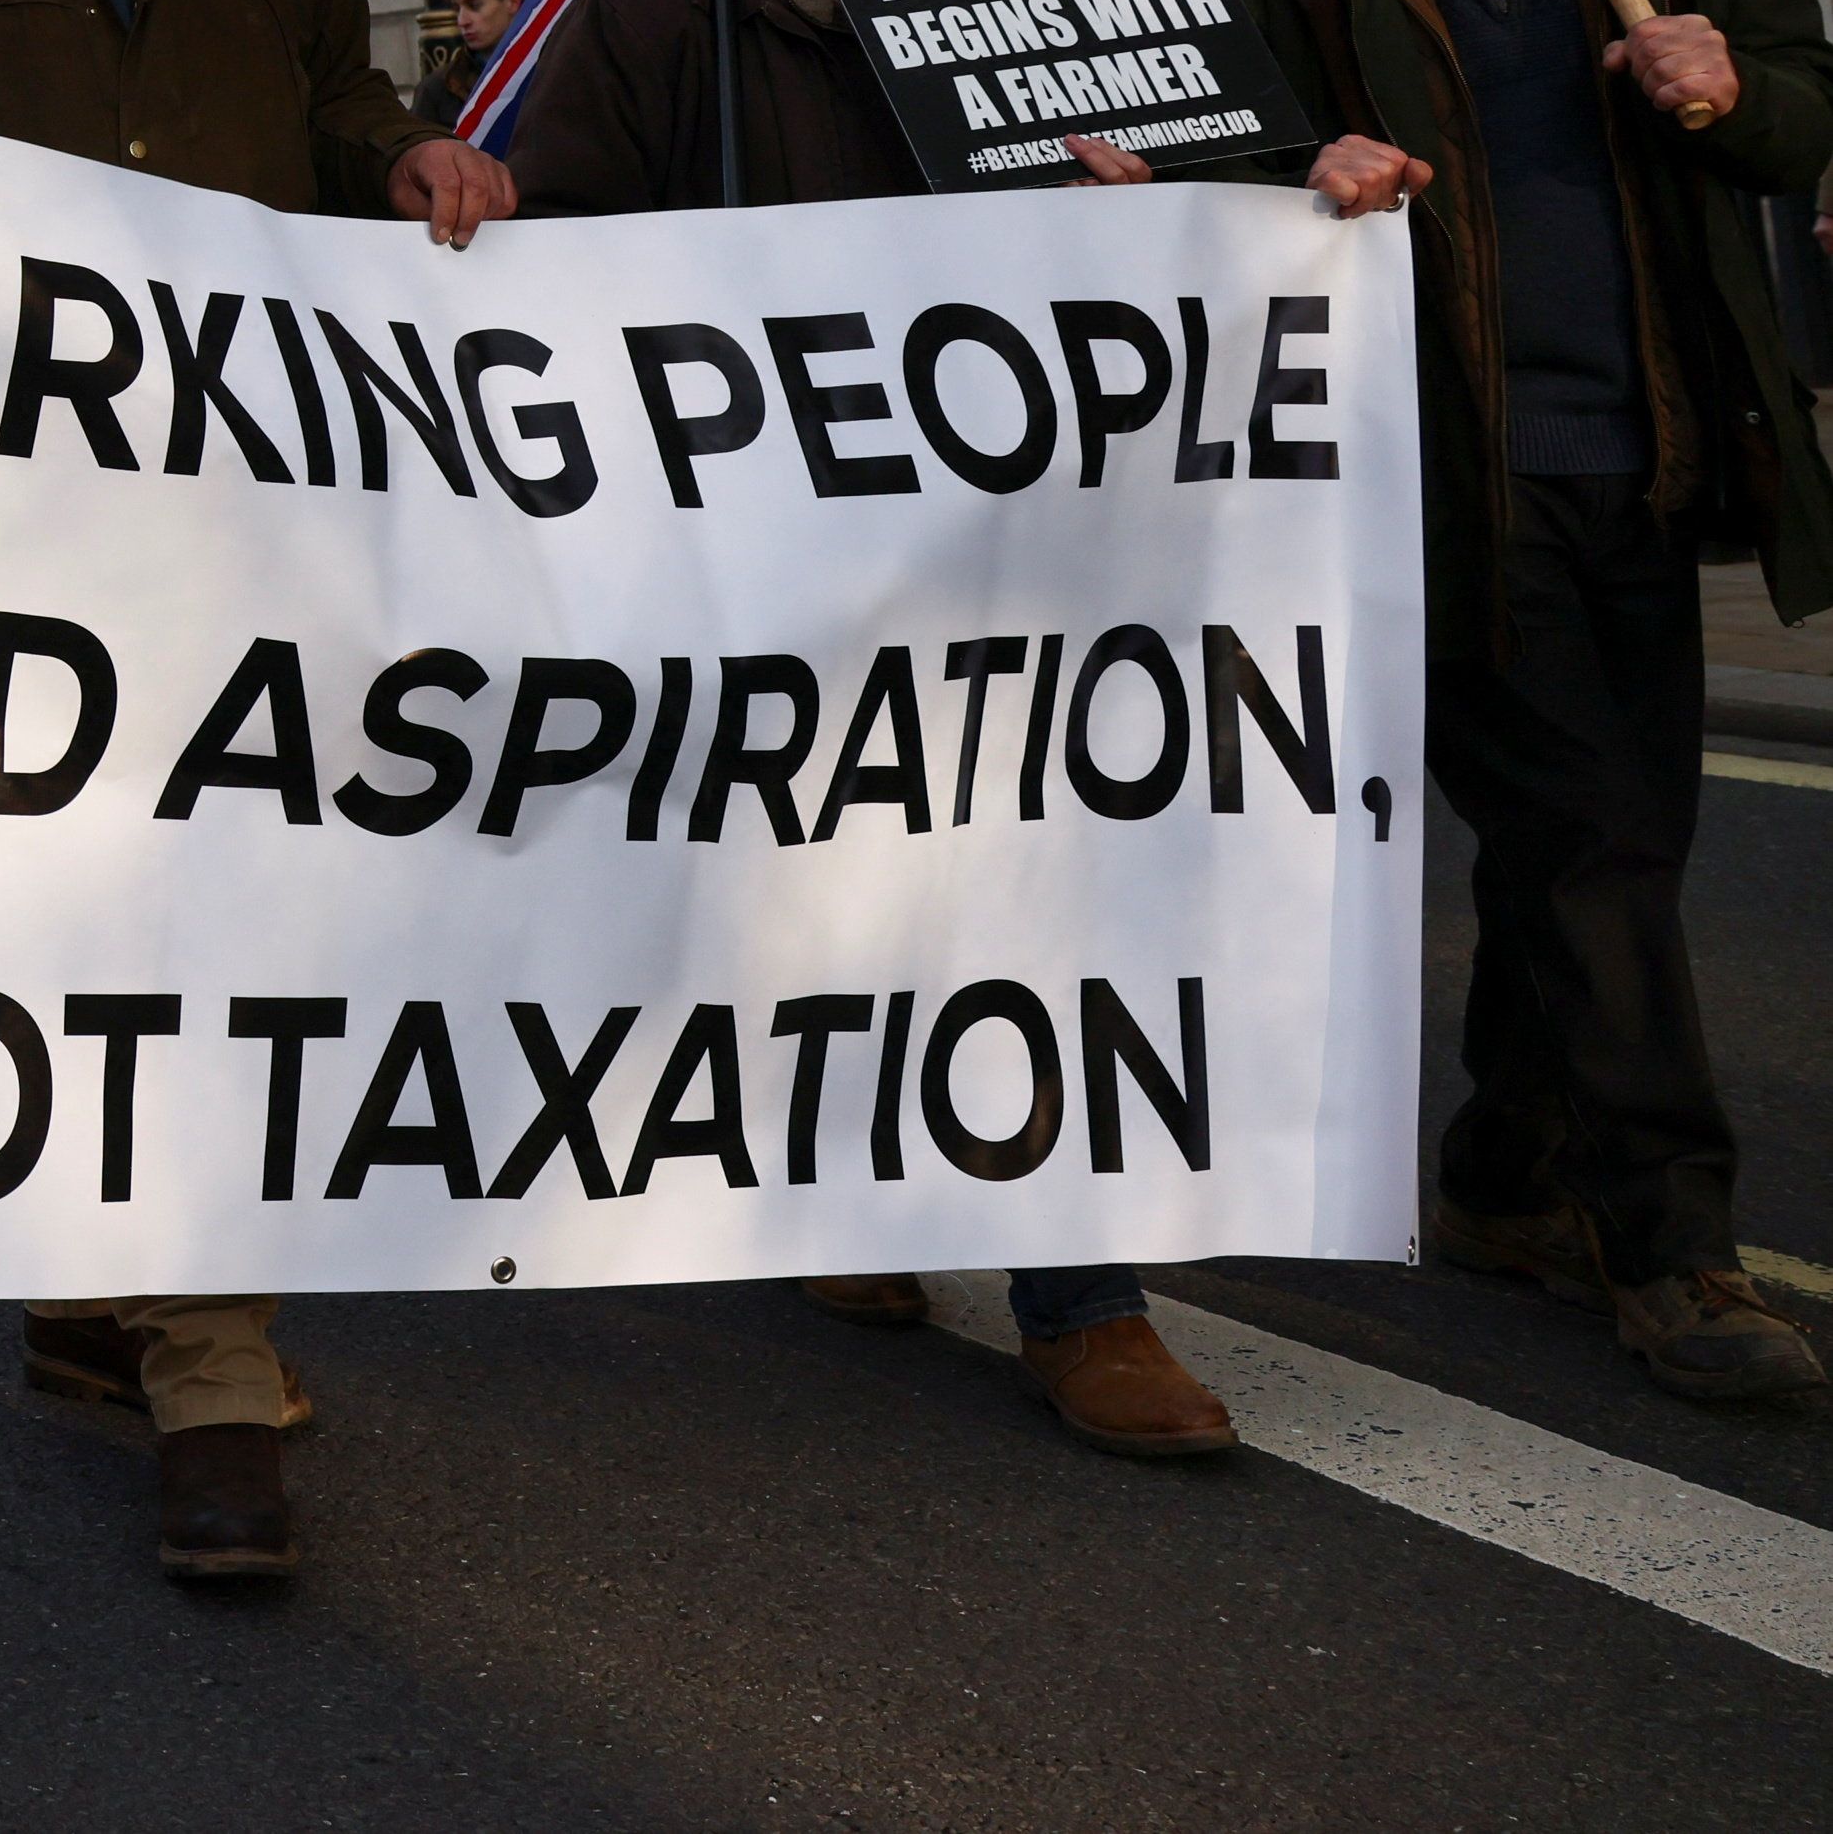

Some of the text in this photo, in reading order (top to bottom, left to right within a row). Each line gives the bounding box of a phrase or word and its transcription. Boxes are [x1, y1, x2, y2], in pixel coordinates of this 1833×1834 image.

[953, 43, 1222, 131] A FARMER
[967, 109, 1263, 174] #BERKSHFARMINGCLUB
[621, 295, 1341, 510] PEOPLE
[152, 623, 1393, 847] ASPIRATION,
[226, 976, 1214, 1202] TAXATION
